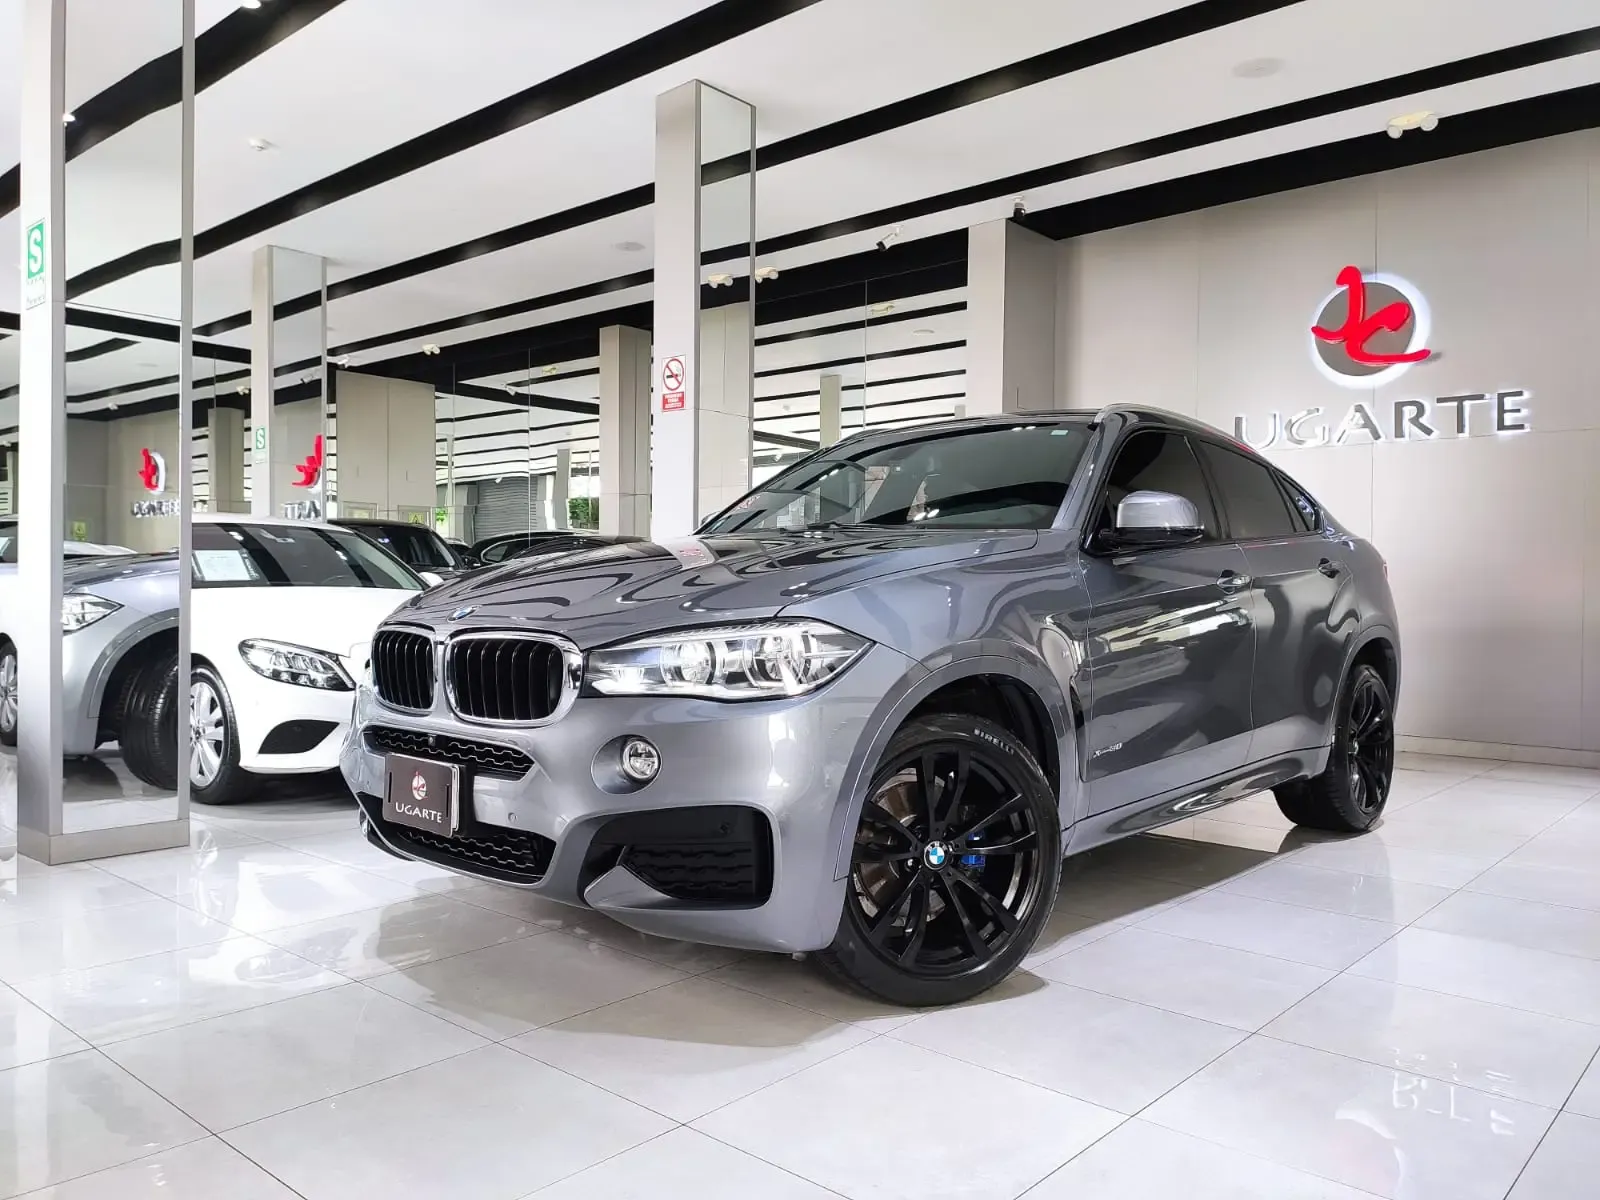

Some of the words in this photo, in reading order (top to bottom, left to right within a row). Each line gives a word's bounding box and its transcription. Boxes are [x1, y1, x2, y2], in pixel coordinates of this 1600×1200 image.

[29, 228, 42, 273] S
[1233, 390, 1532, 449] UGARTE
[256, 428, 265, 449] S
[395, 801, 443, 824] UGARTE
